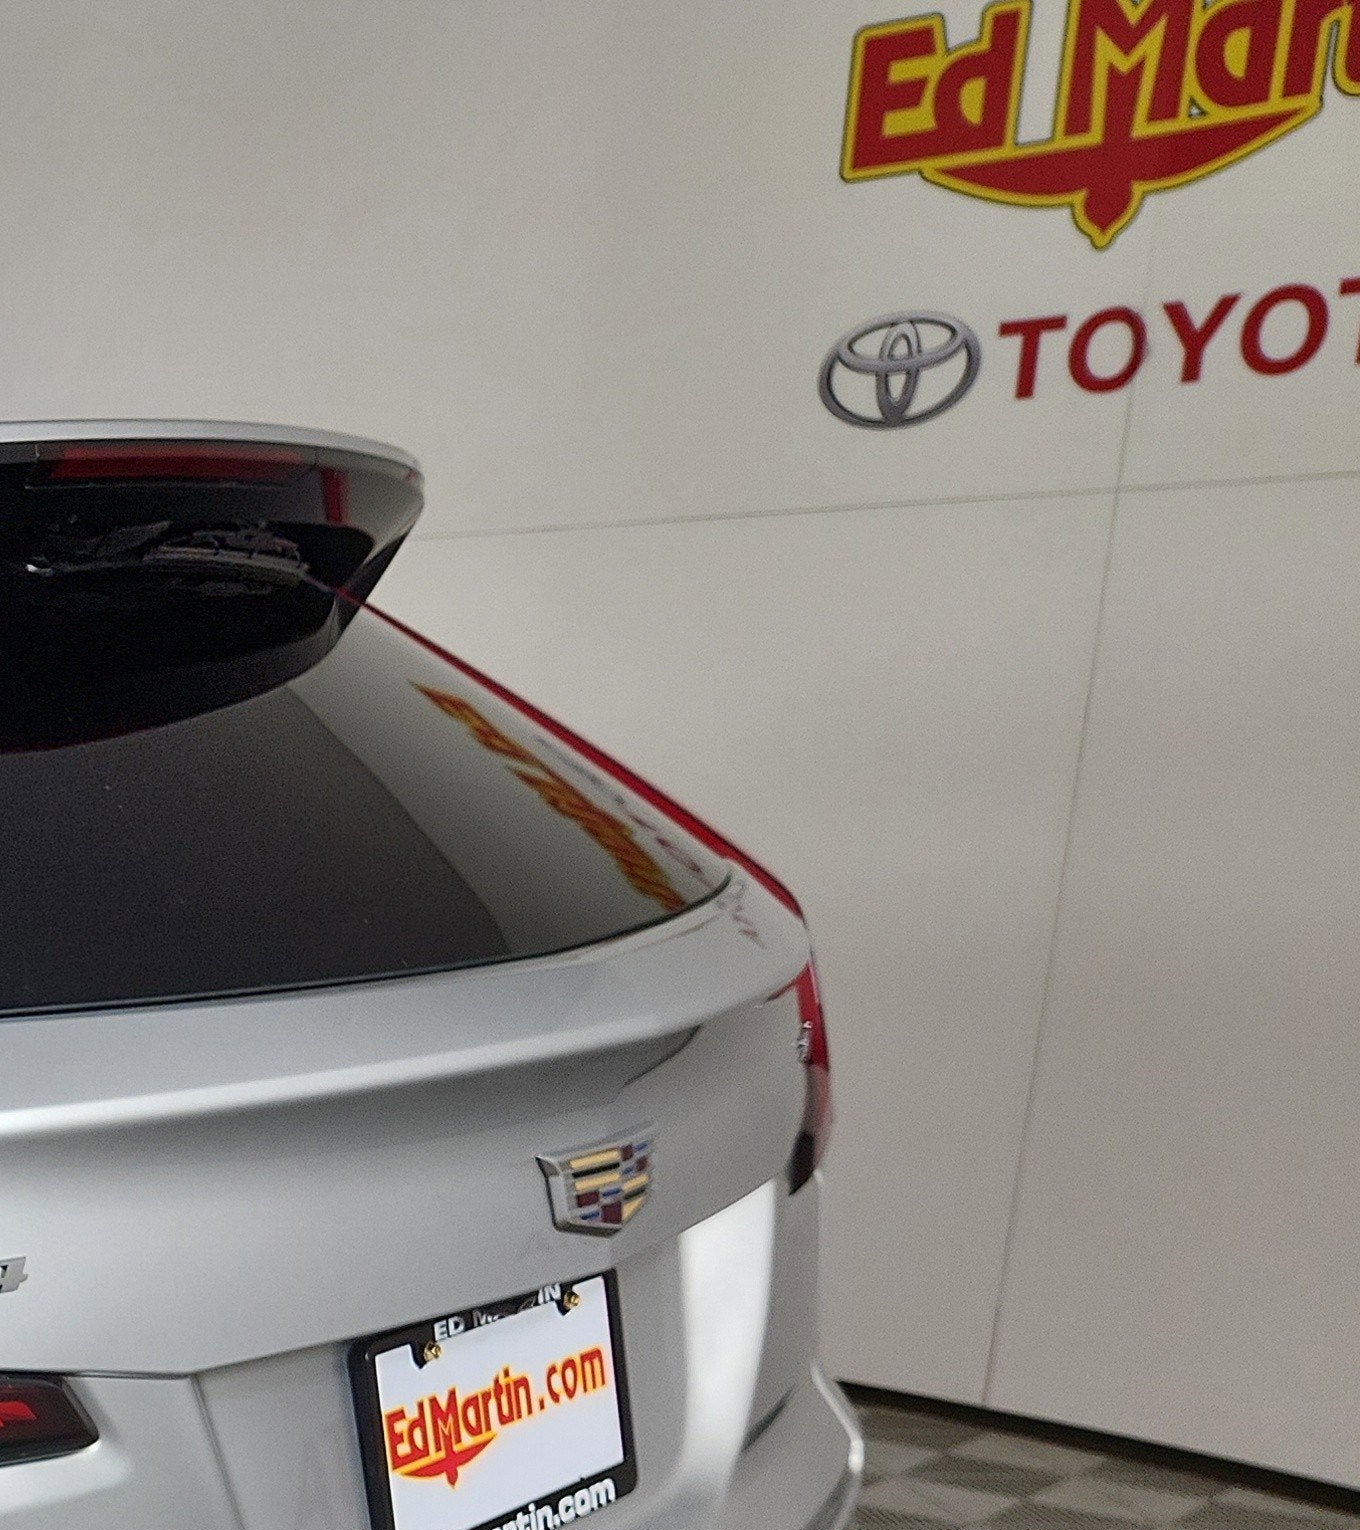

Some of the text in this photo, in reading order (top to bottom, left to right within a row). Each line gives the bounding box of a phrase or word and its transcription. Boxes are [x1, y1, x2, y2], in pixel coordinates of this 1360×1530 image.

[846, 0, 1360, 172] Ed Mar
[433, 1314, 467, 1342] ED
[384, 1347, 607, 1474] EdMartin.com
